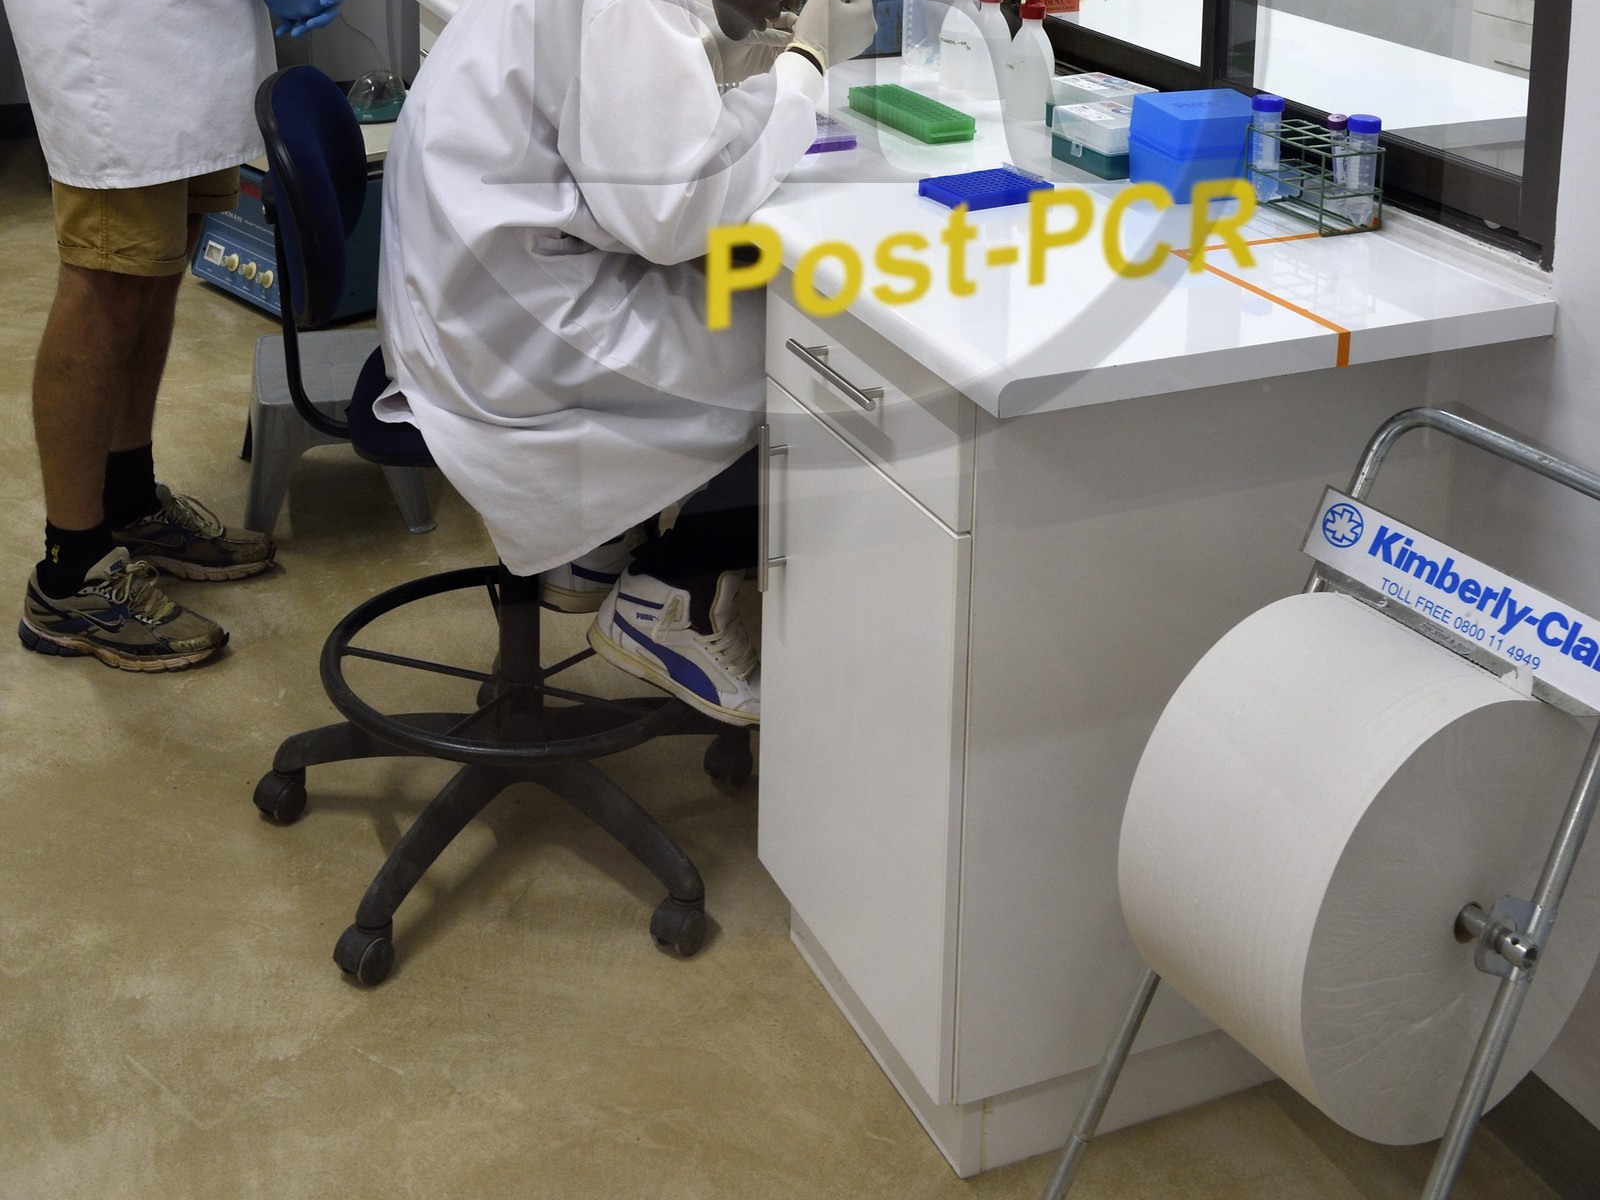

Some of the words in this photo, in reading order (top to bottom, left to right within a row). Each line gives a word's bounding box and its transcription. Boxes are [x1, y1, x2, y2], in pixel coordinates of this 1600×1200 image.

[703, 178, 1260, 332] Post-PCR
[1381, 576, 1411, 605] TOLL
[1414, 596, 1453, 625] FREE
[1453, 615, 1486, 642] 0800
[1488, 634, 1503, 651] 11
[1506, 644, 1542, 671] 4949
